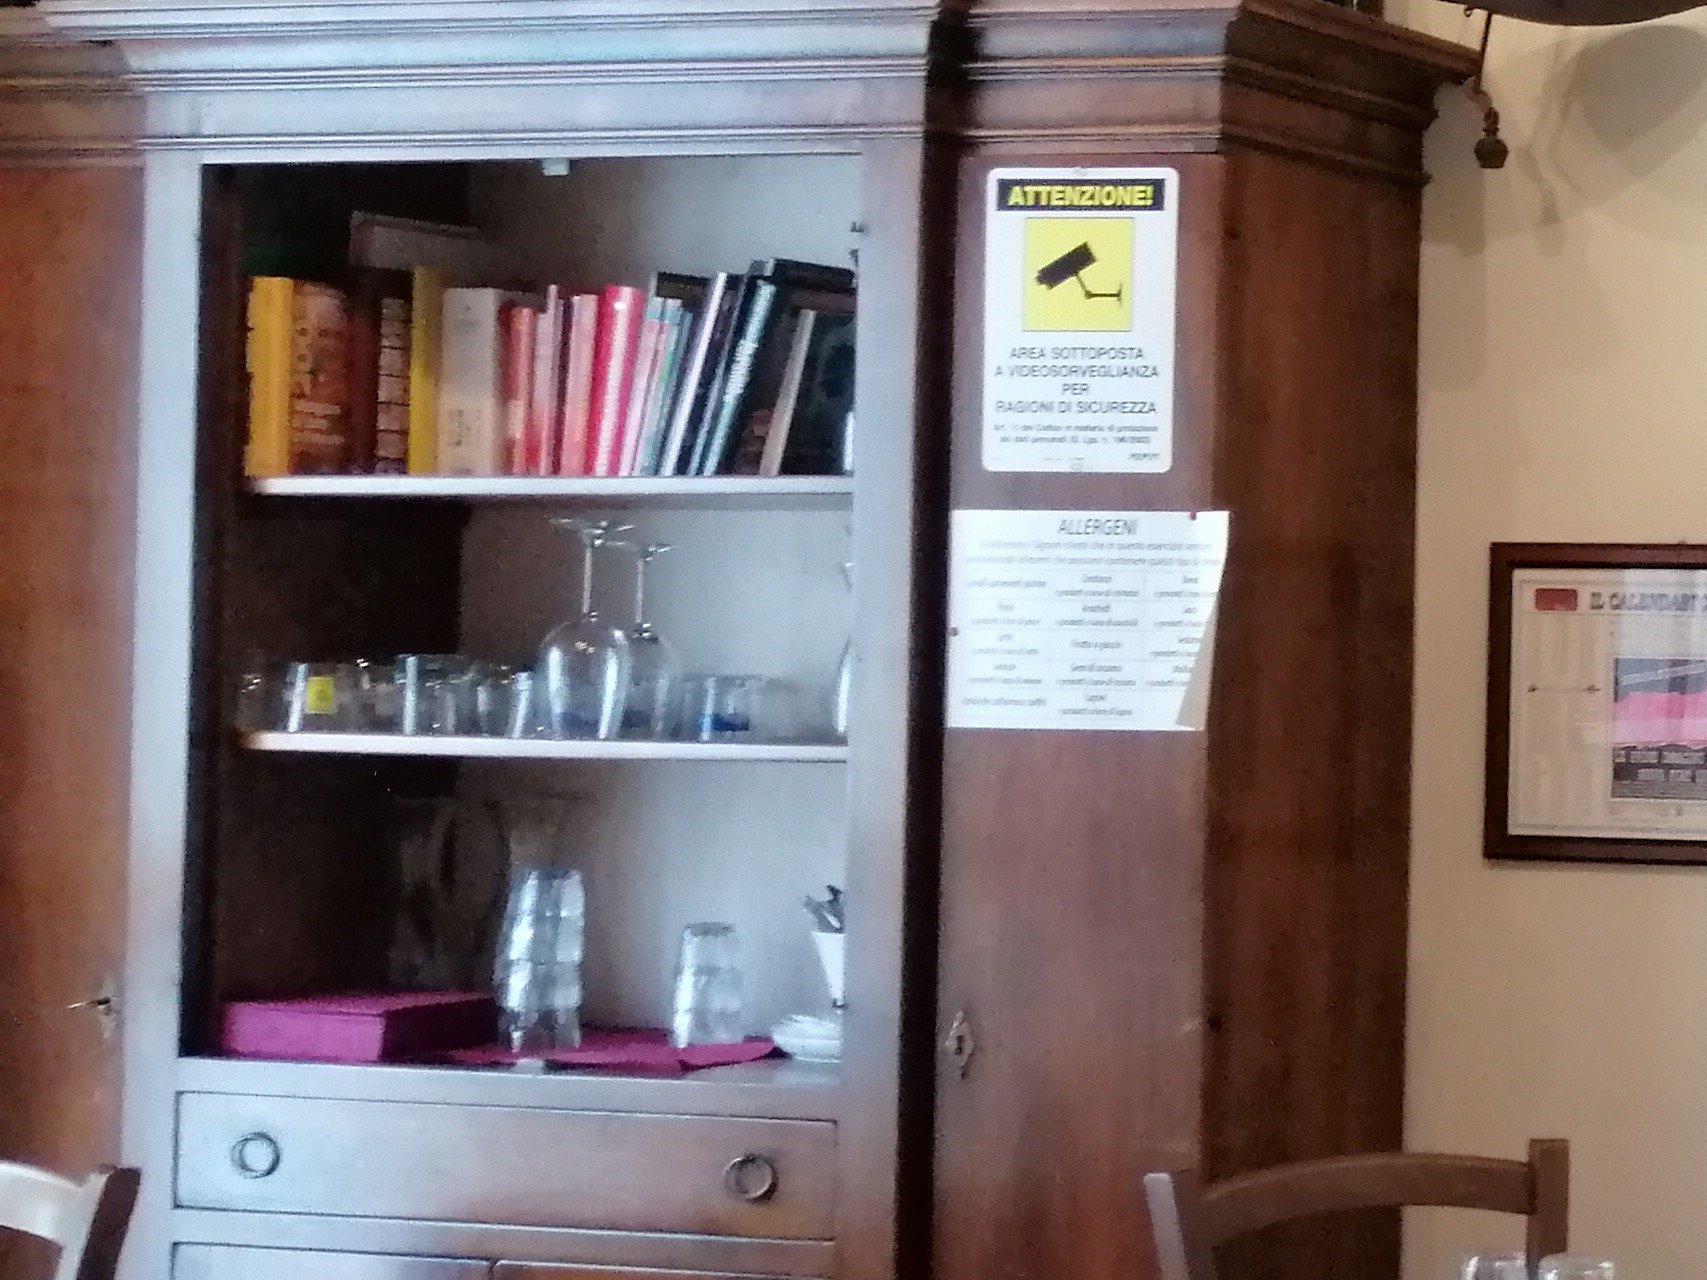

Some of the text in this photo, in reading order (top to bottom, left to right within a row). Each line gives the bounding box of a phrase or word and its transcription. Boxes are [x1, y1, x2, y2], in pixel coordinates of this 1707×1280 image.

[1008, 185, 1155, 208] ATTENZIONE!
[1010, 346, 1144, 360] AREA SOTTOPOSTA
[994, 364, 1159, 378] A VIDEOSORVEGLIANZA
[1061, 382, 1090, 396] PER
[996, 400, 1157, 415] RAGIONI DI SICUREZZA
[1057, 518, 1138, 536] ALLERGENI
